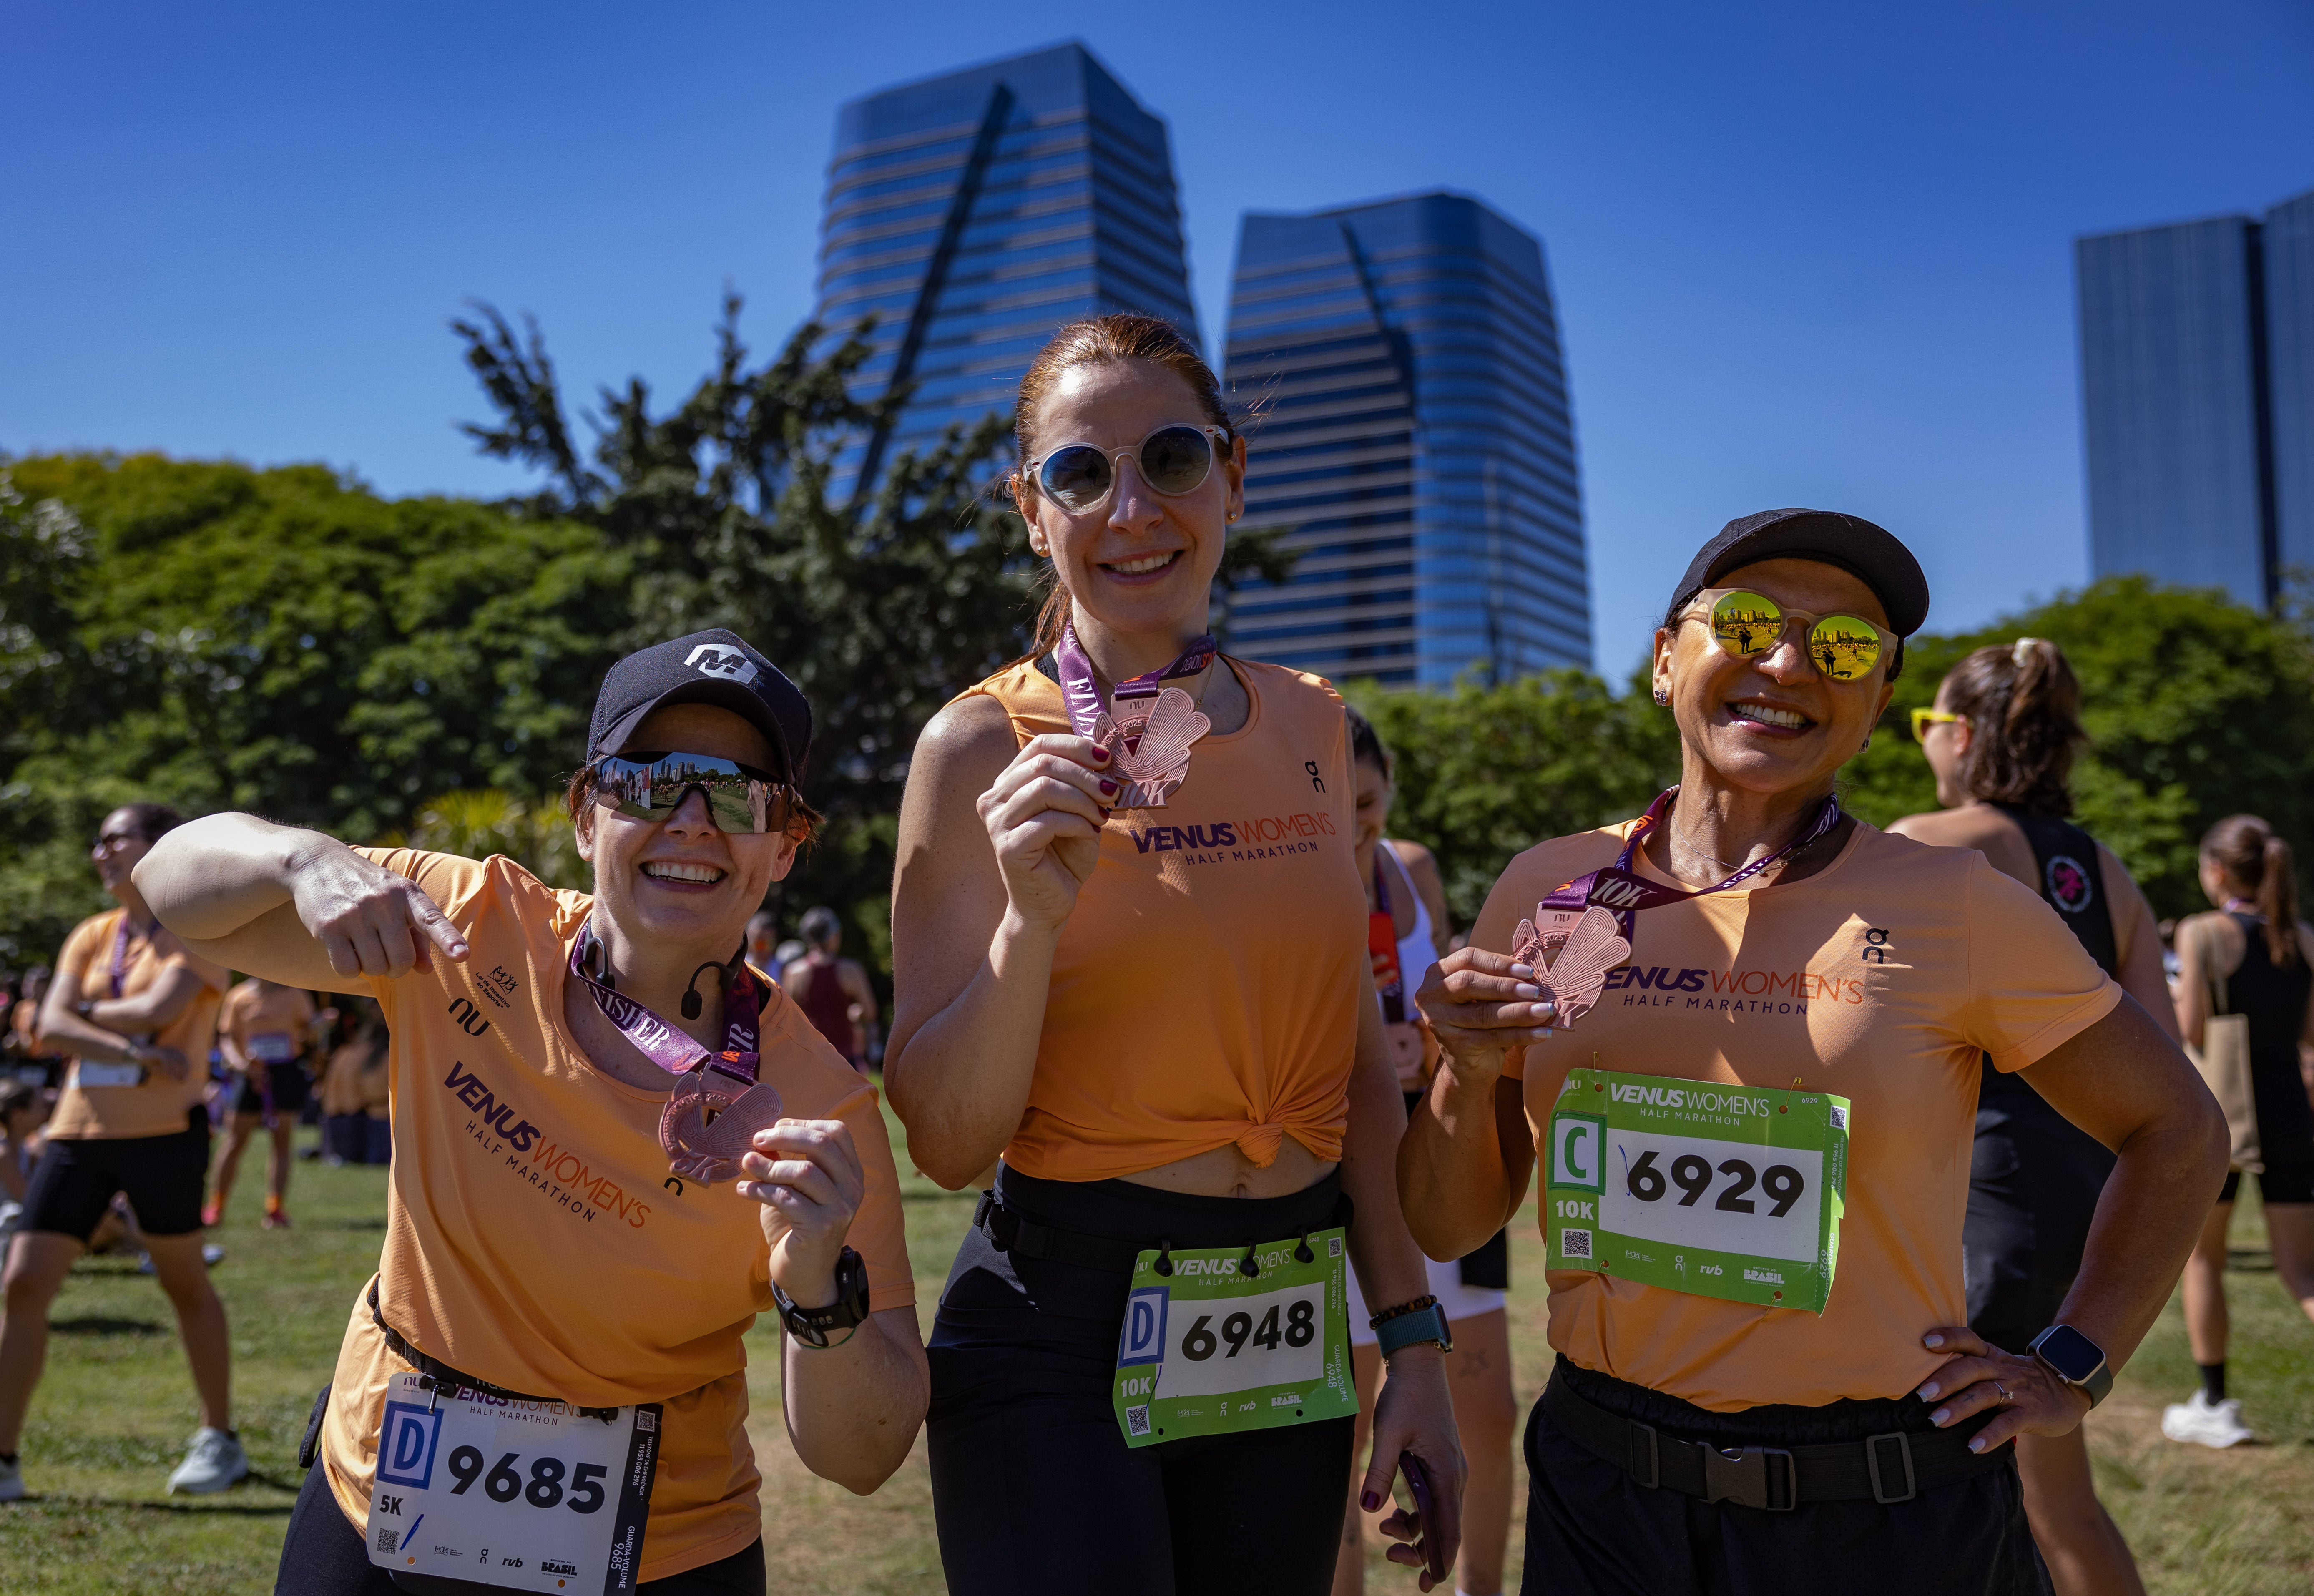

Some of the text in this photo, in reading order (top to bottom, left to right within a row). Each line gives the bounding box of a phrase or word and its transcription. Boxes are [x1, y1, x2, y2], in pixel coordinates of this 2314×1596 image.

[1067, 676, 1100, 742] FINIS
[1123, 720, 1143, 730] 2025
[1113, 779, 1178, 809] 10K
[1185, 840, 1319, 866] HALF MARATHON
[1590, 877, 1657, 907] 10K
[1544, 933, 1563, 943] 2025
[483, 988, 501, 1007] Esporte
[489, 986, 510, 1008] Incentivo
[1623, 995, 1806, 1015] HALF MARATHON
[585, 981, 670, 1051] NISHER
[1640, 1108, 1740, 1126] HALF MARATHON
[1564, 1126, 1587, 1179] C
[465, 1120, 597, 1222] HALF MARATHON
[1627, 1150, 1805, 1218] 6929
[1556, 1200, 1594, 1221] 10K
[1700, 1265, 1723, 1276] rvb
[1744, 1269, 1785, 1284] BRASIL
[1823, 1233, 1835, 1299] GUARDA-VOLUME
[1130, 1301, 1154, 1352] D
[1182, 1299, 1315, 1362] 6948
[1326, 1363, 1337, 1388] 6948
[1334, 1345, 1349, 1402] GUARDA-VOLUME
[1121, 1377, 1151, 1397] 10K
[1239, 1400, 1256, 1412] rvb
[1271, 1394, 1302, 1407] BRASIL
[470, 1406, 558, 1425] HALF MARATHON
[393, 1418, 425, 1470] D
[448, 1445, 608, 1514] 9685
[638, 1466, 648, 1496] EMERGÊNCIA
[379, 1495, 404, 1516] 5K
[502, 1557, 523, 1568] rvb
[541, 1561, 578, 1576] BRASIL
[611, 1543, 625, 1570] 9685
[618, 1526, 635, 1588] GUARDA-VOLUME
